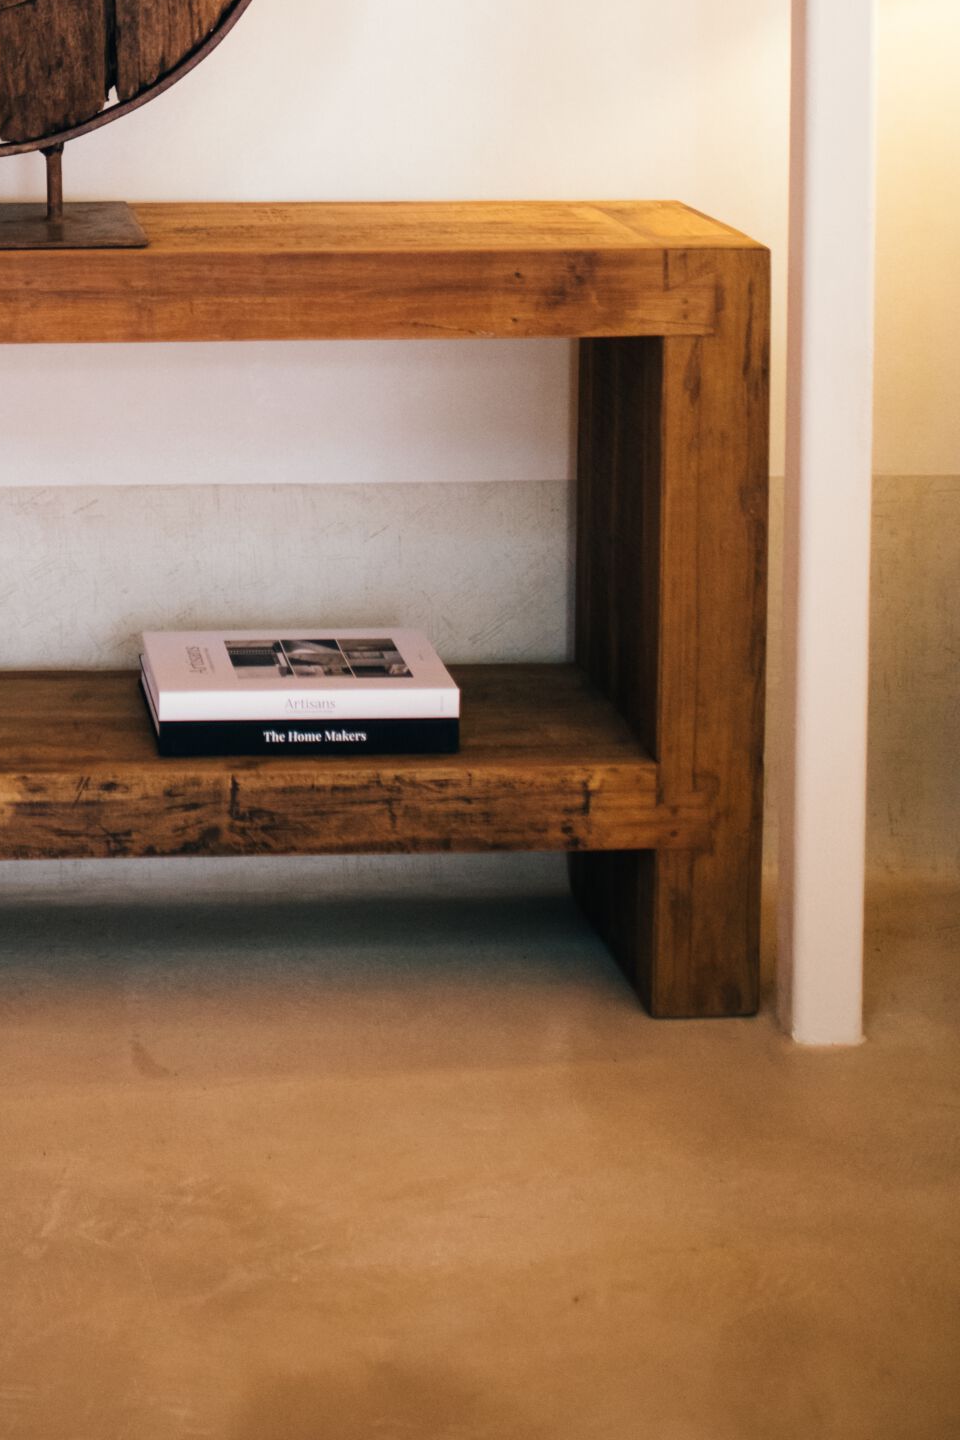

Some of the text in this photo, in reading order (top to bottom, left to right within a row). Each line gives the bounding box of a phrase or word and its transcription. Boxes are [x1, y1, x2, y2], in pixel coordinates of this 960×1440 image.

[285, 698, 336, 709] Artisans
[263, 729, 367, 742] The Home Makers
